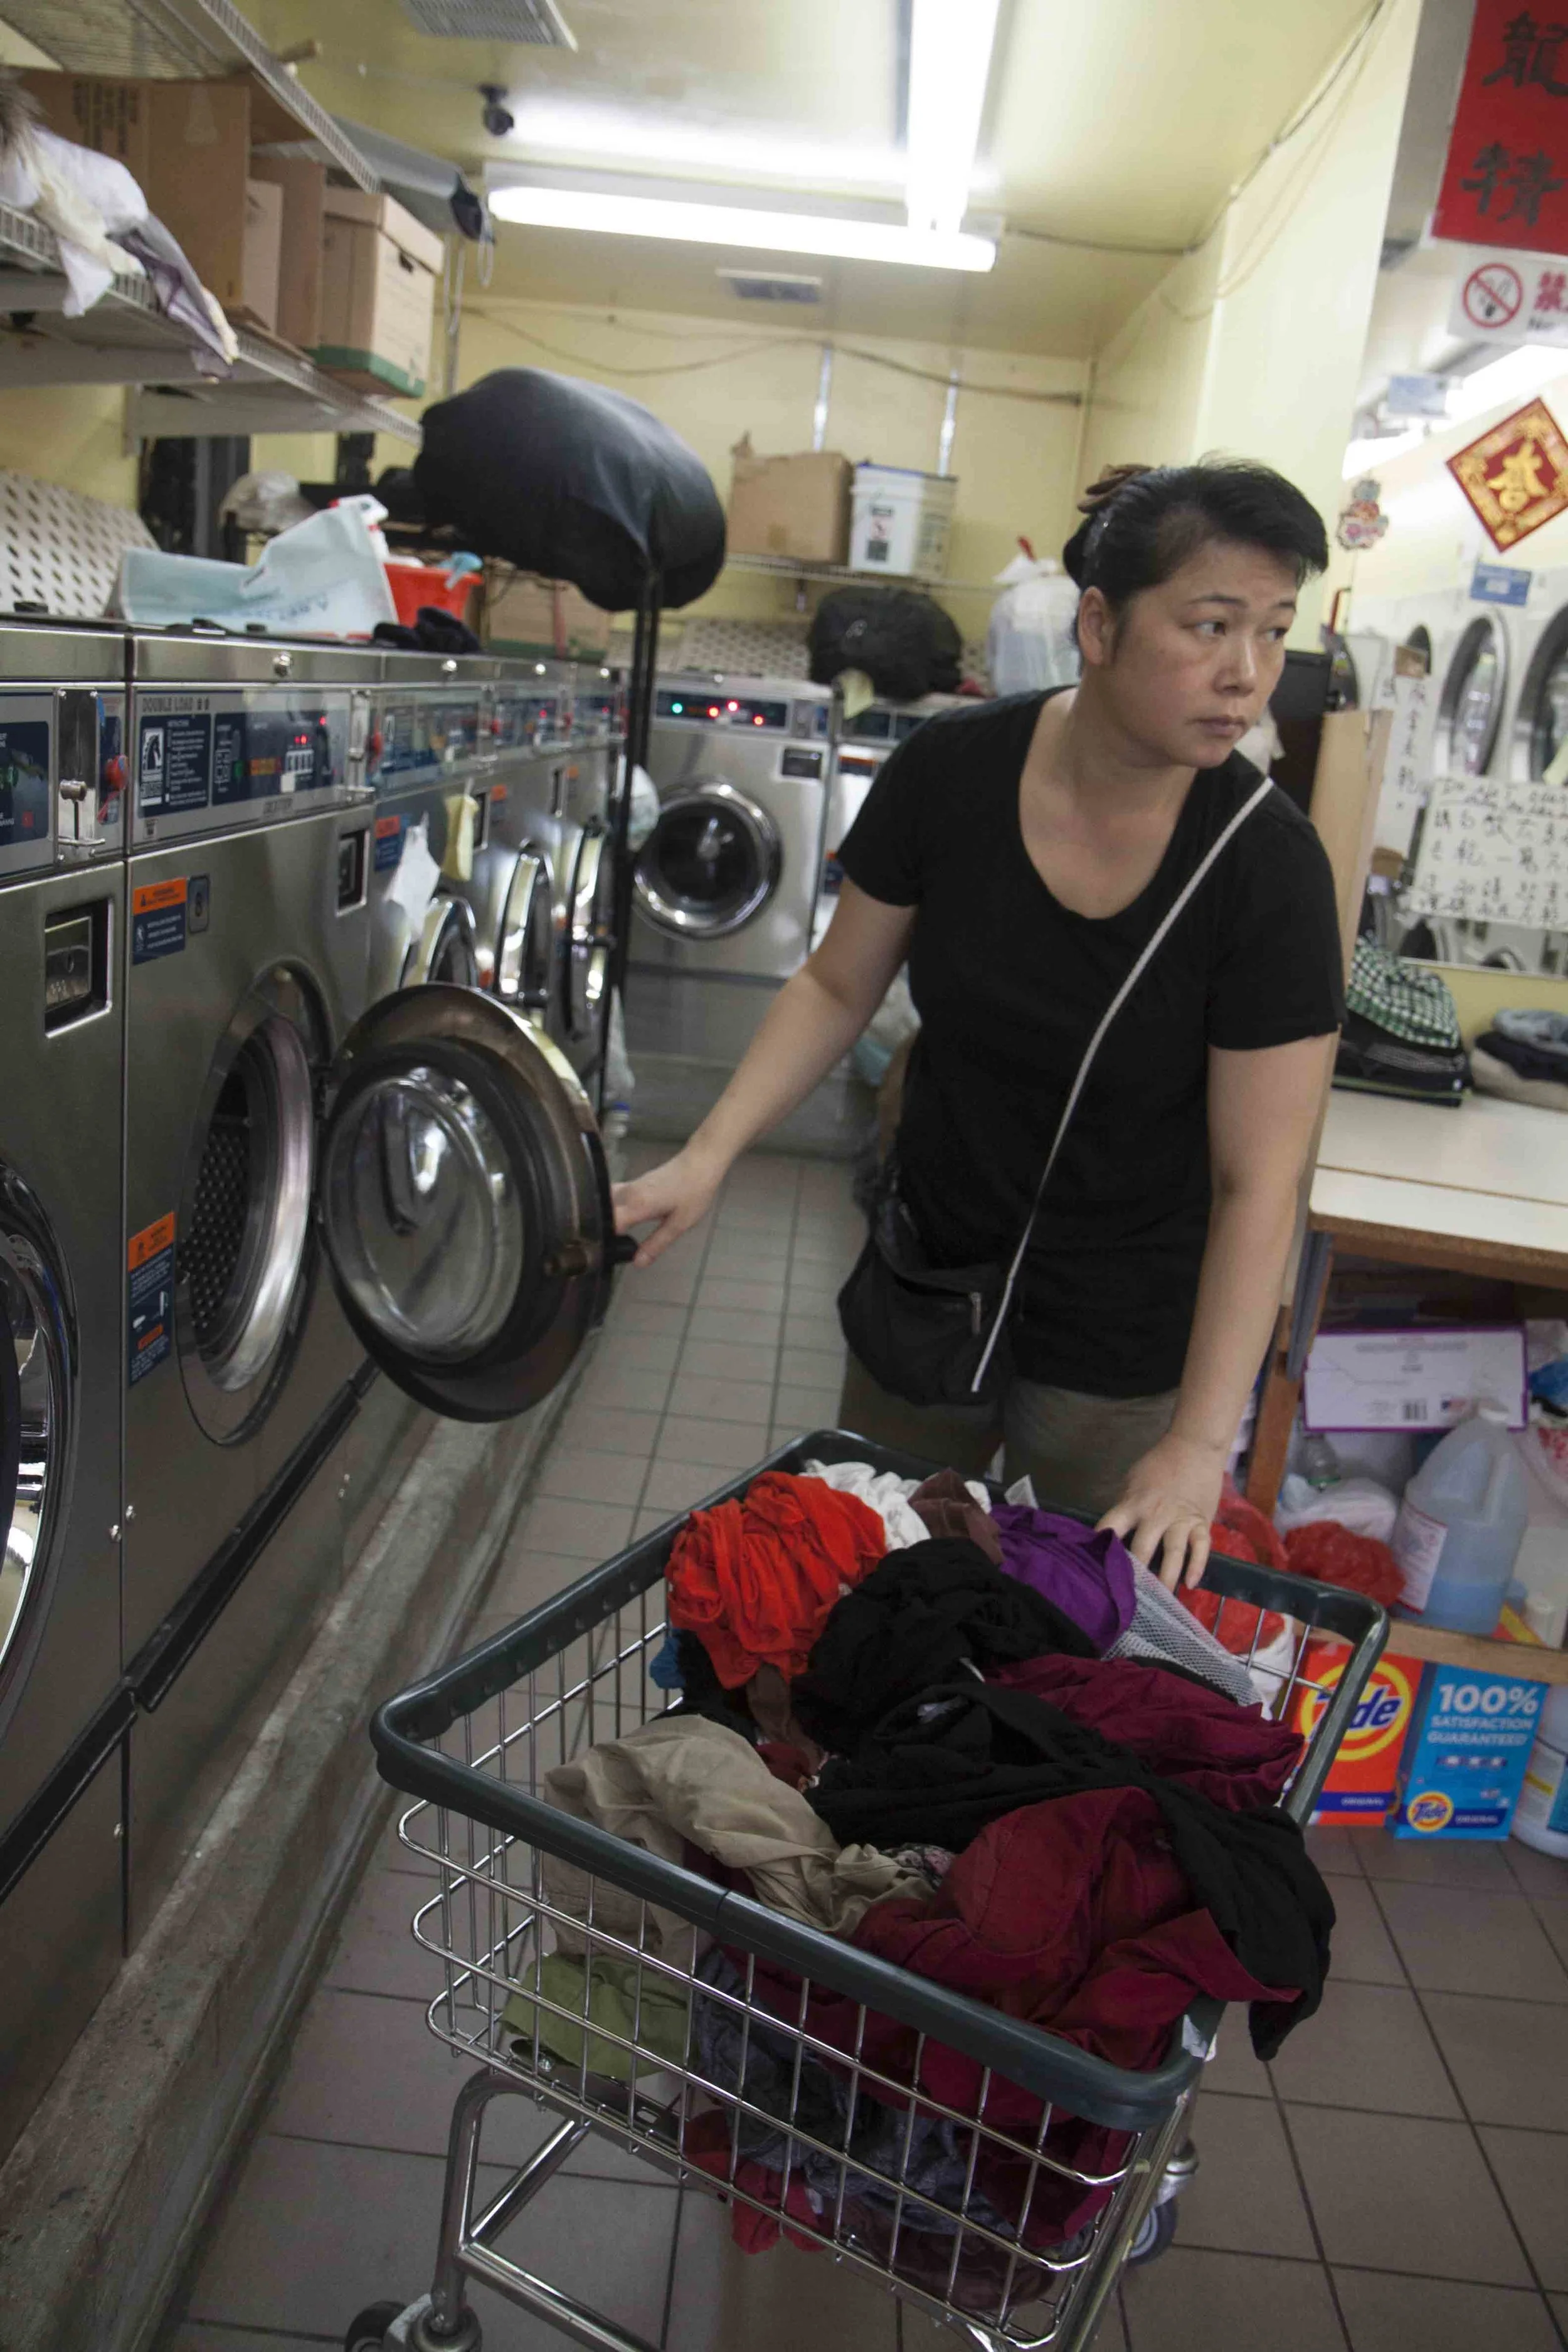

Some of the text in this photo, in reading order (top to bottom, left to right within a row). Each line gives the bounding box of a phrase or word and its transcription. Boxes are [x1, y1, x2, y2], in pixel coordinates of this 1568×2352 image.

[1440, 1683, 1539, 1715] 100%
[1431, 1715, 1535, 1730] SATISFACTION
[1427, 1730, 1528, 1746] GUARANTEED
